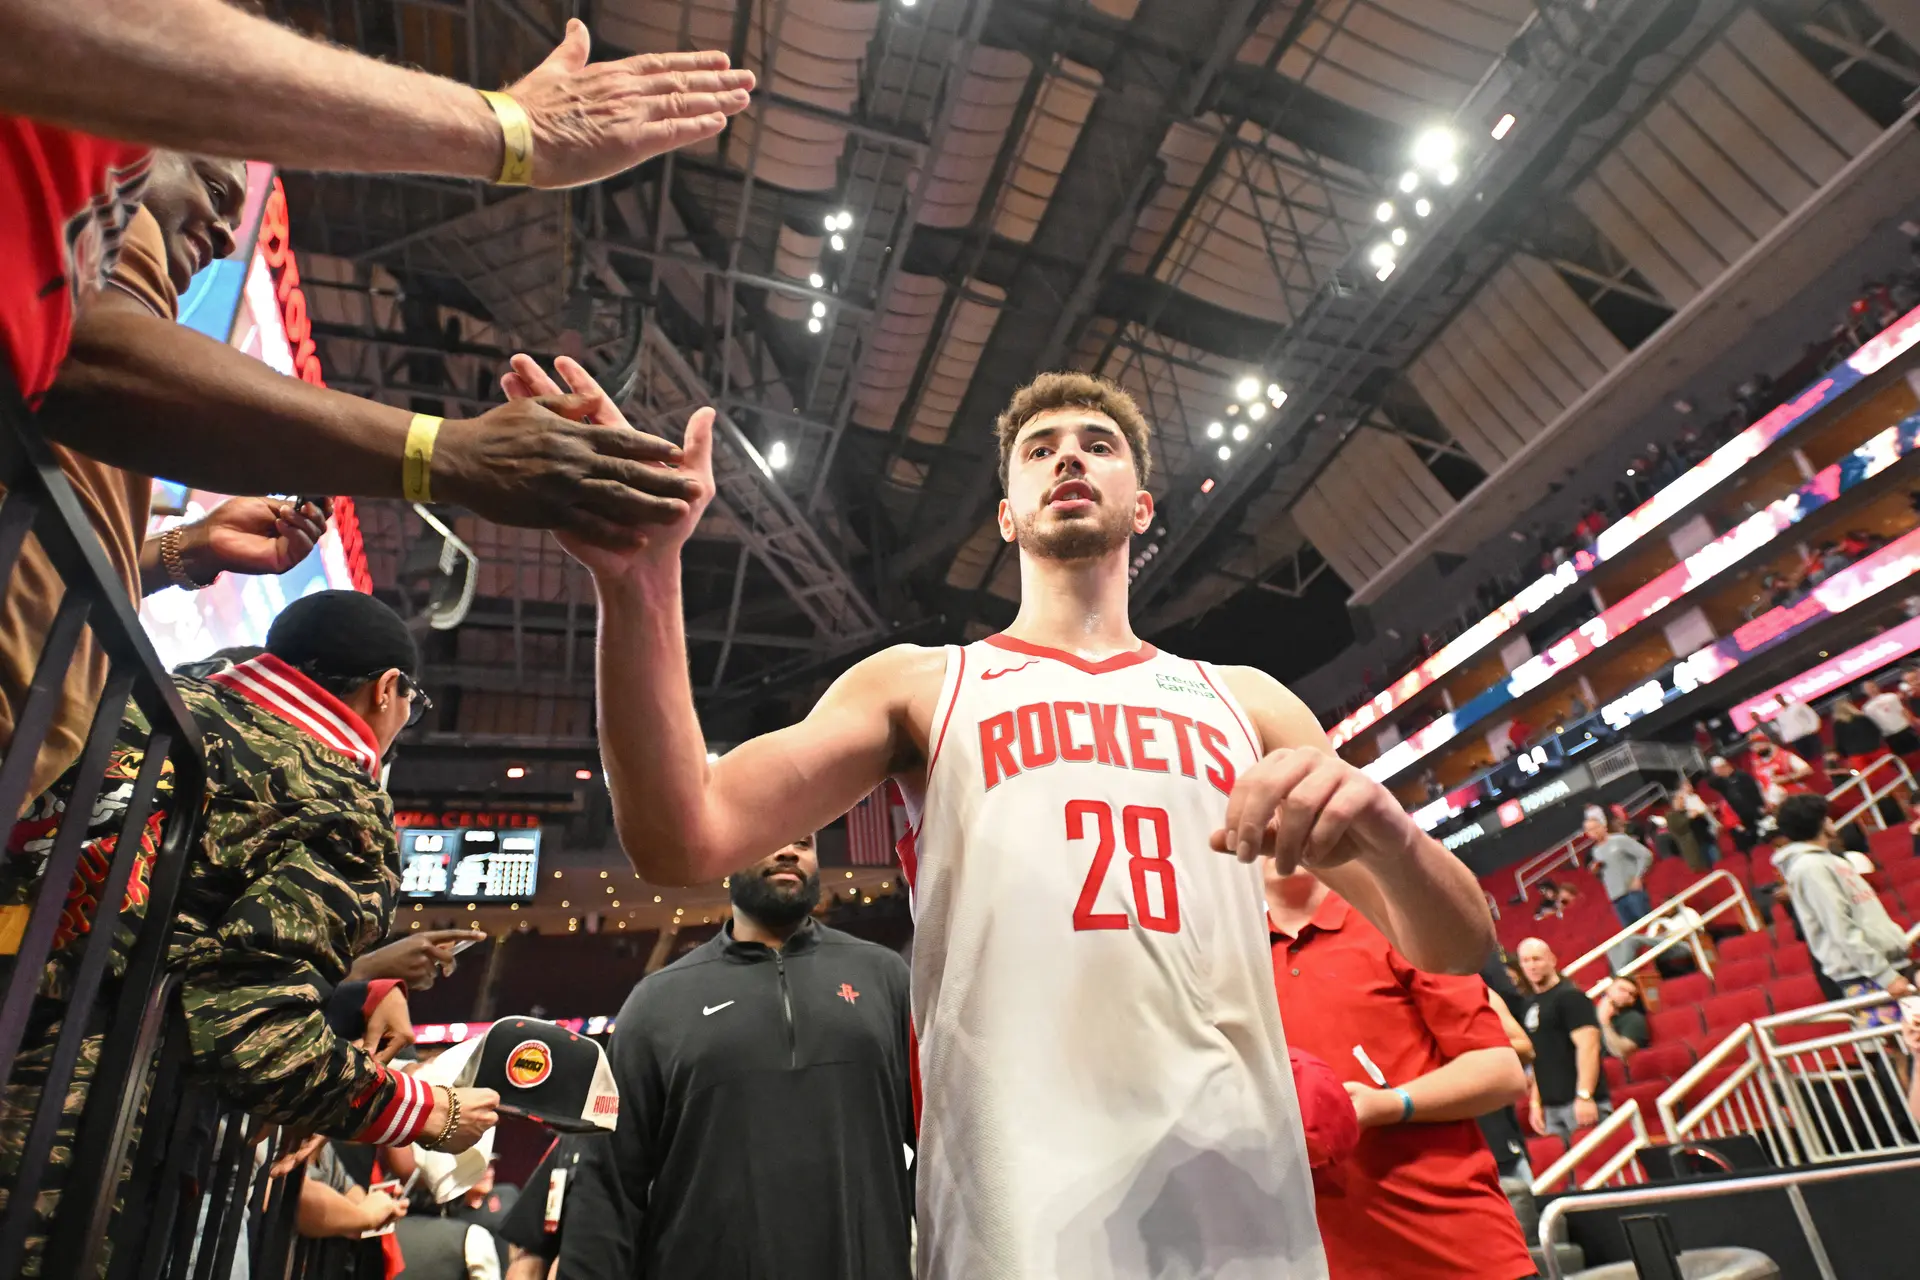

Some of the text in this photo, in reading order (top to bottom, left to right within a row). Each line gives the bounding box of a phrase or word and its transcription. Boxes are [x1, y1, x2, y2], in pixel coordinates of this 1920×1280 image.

[1155, 673, 1208, 690] credit
[1155, 678, 1215, 699] karma
[977, 700, 1236, 798] ROCKETS
[441, 811, 541, 829] CENTER
[1064, 799, 1181, 934] 28
